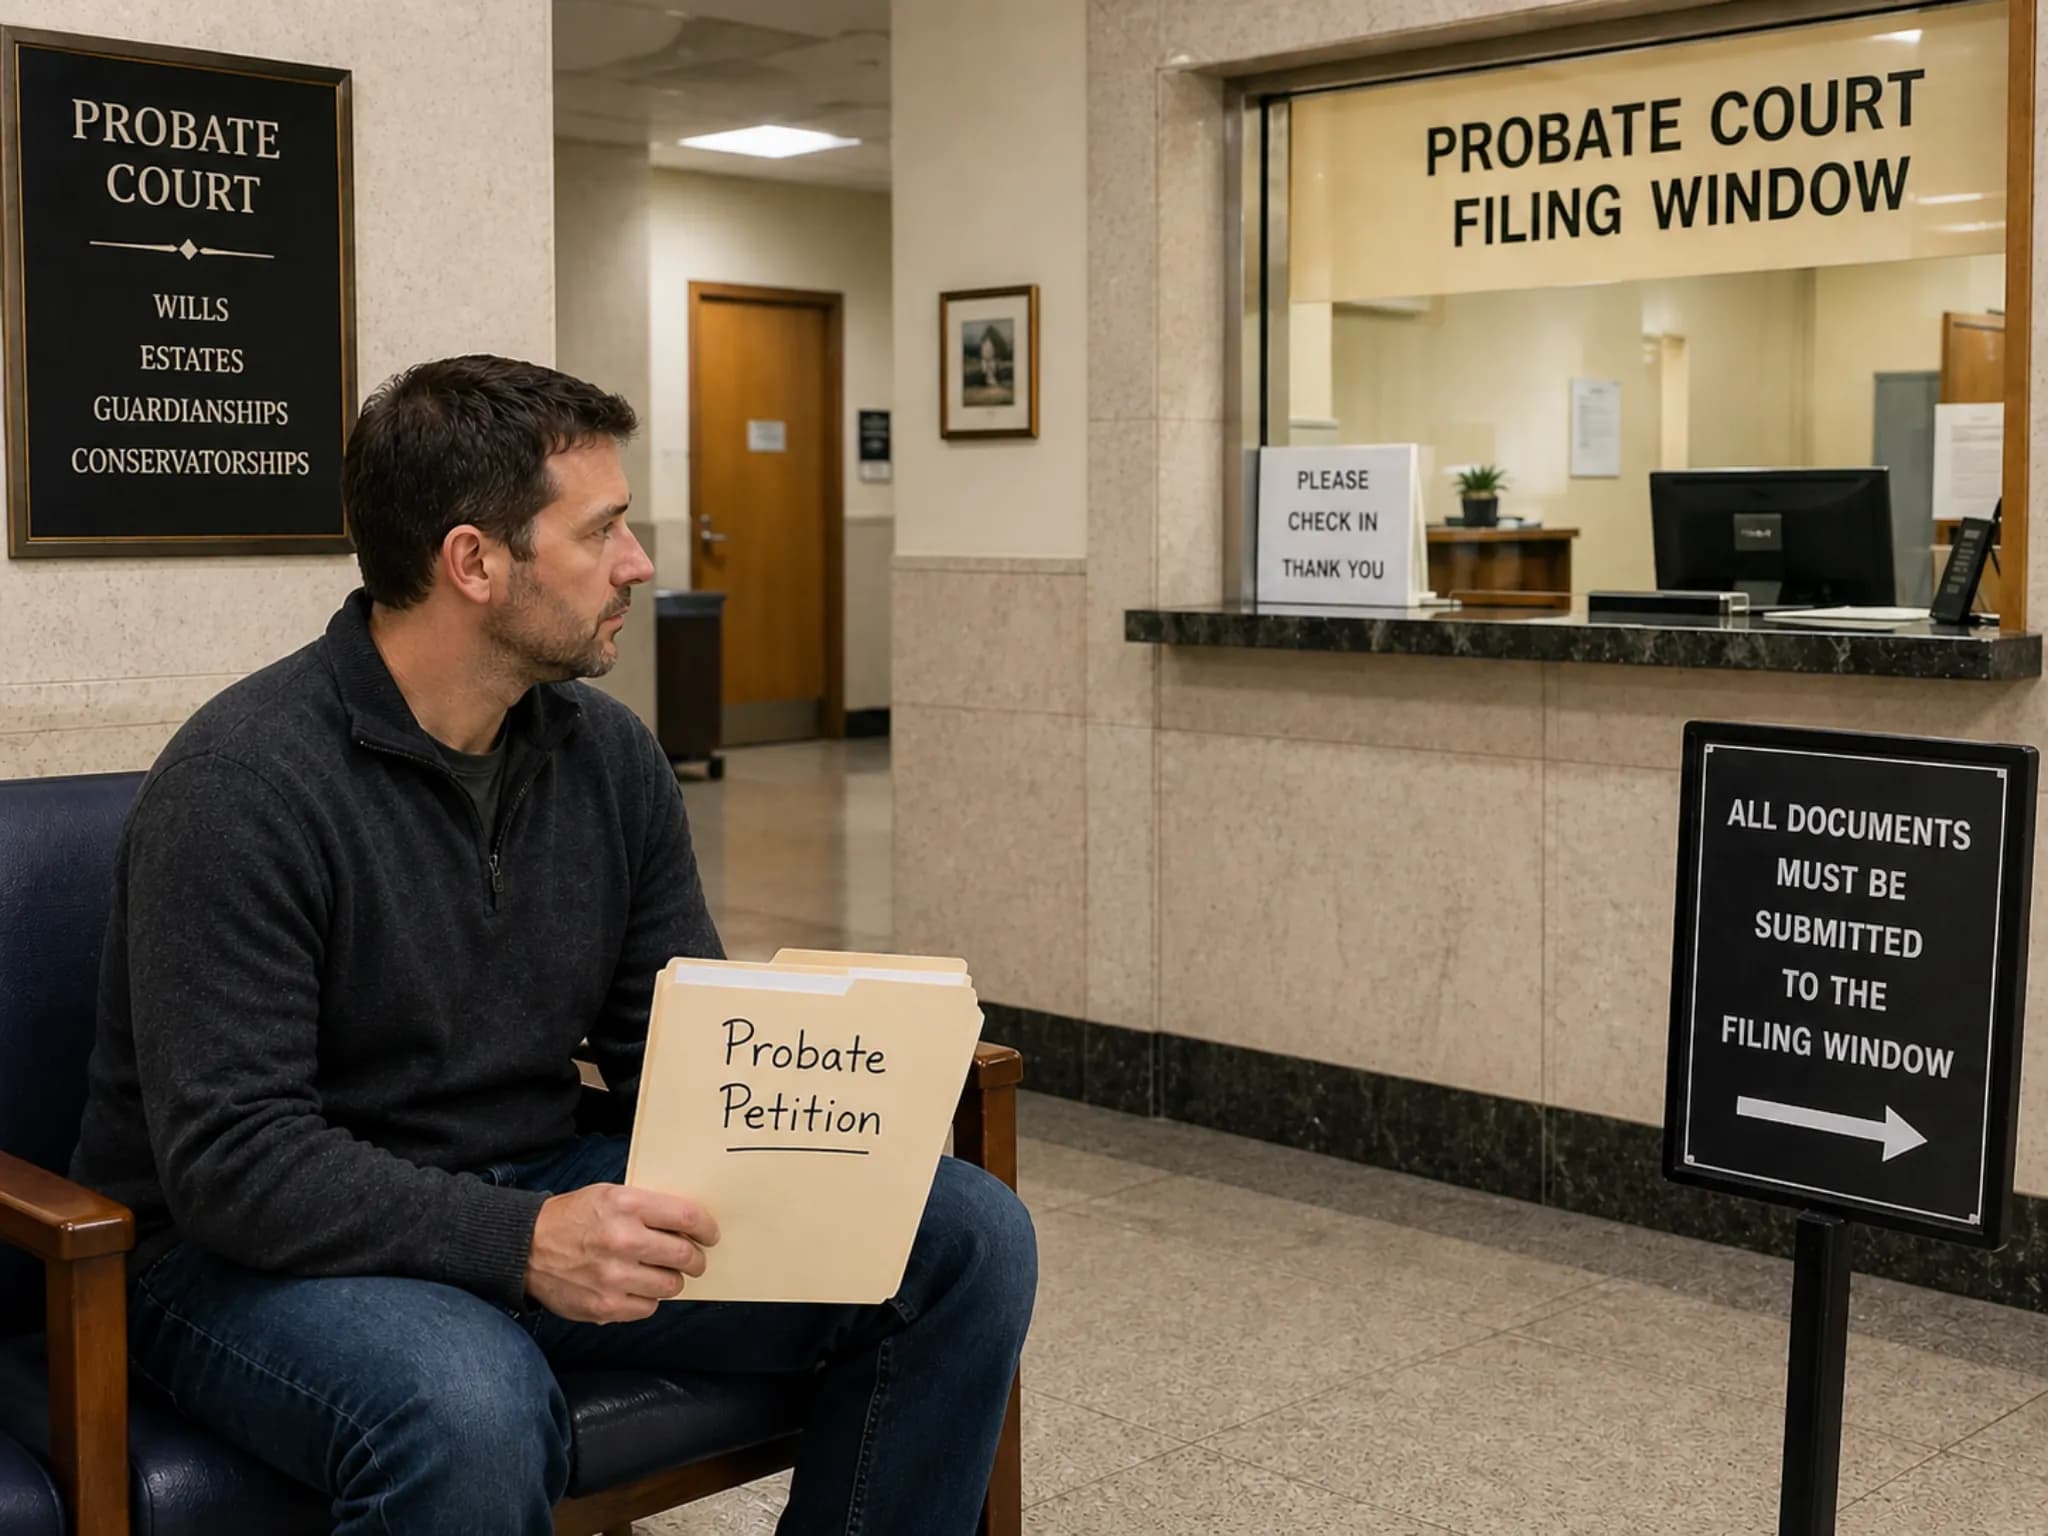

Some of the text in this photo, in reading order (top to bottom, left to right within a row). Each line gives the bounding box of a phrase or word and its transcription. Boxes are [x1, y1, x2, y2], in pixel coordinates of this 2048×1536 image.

[73, 99, 280, 158] PROBATE
[1428, 69, 1925, 176] PROBATE COURT
[107, 164, 260, 213] COURT
[1455, 156, 1910, 247] FILING WINDOW
[154, 294, 228, 321] WILLS
[141, 345, 243, 373] ESTATES
[94, 396, 288, 425] GUARDIANSHIPS
[72, 448, 309, 475] CONSERVATORSHIPS
[1298, 470, 1368, 489] PLEASE
[1289, 512, 1377, 531] CHECK IN
[1284, 559, 1383, 579] THANK YOU
[1728, 799, 1970, 850] ALL DOCUMENTS
[1778, 858, 1906, 900] MUST BE
[1755, 911, 1922, 958] SUBMITTED
[1783, 969, 1886, 1011] TO THE
[722, 1019, 885, 1073] Probate
[1722, 1015, 1954, 1078] FILING WINDOW
[720, 1083, 879, 1134] Petition
